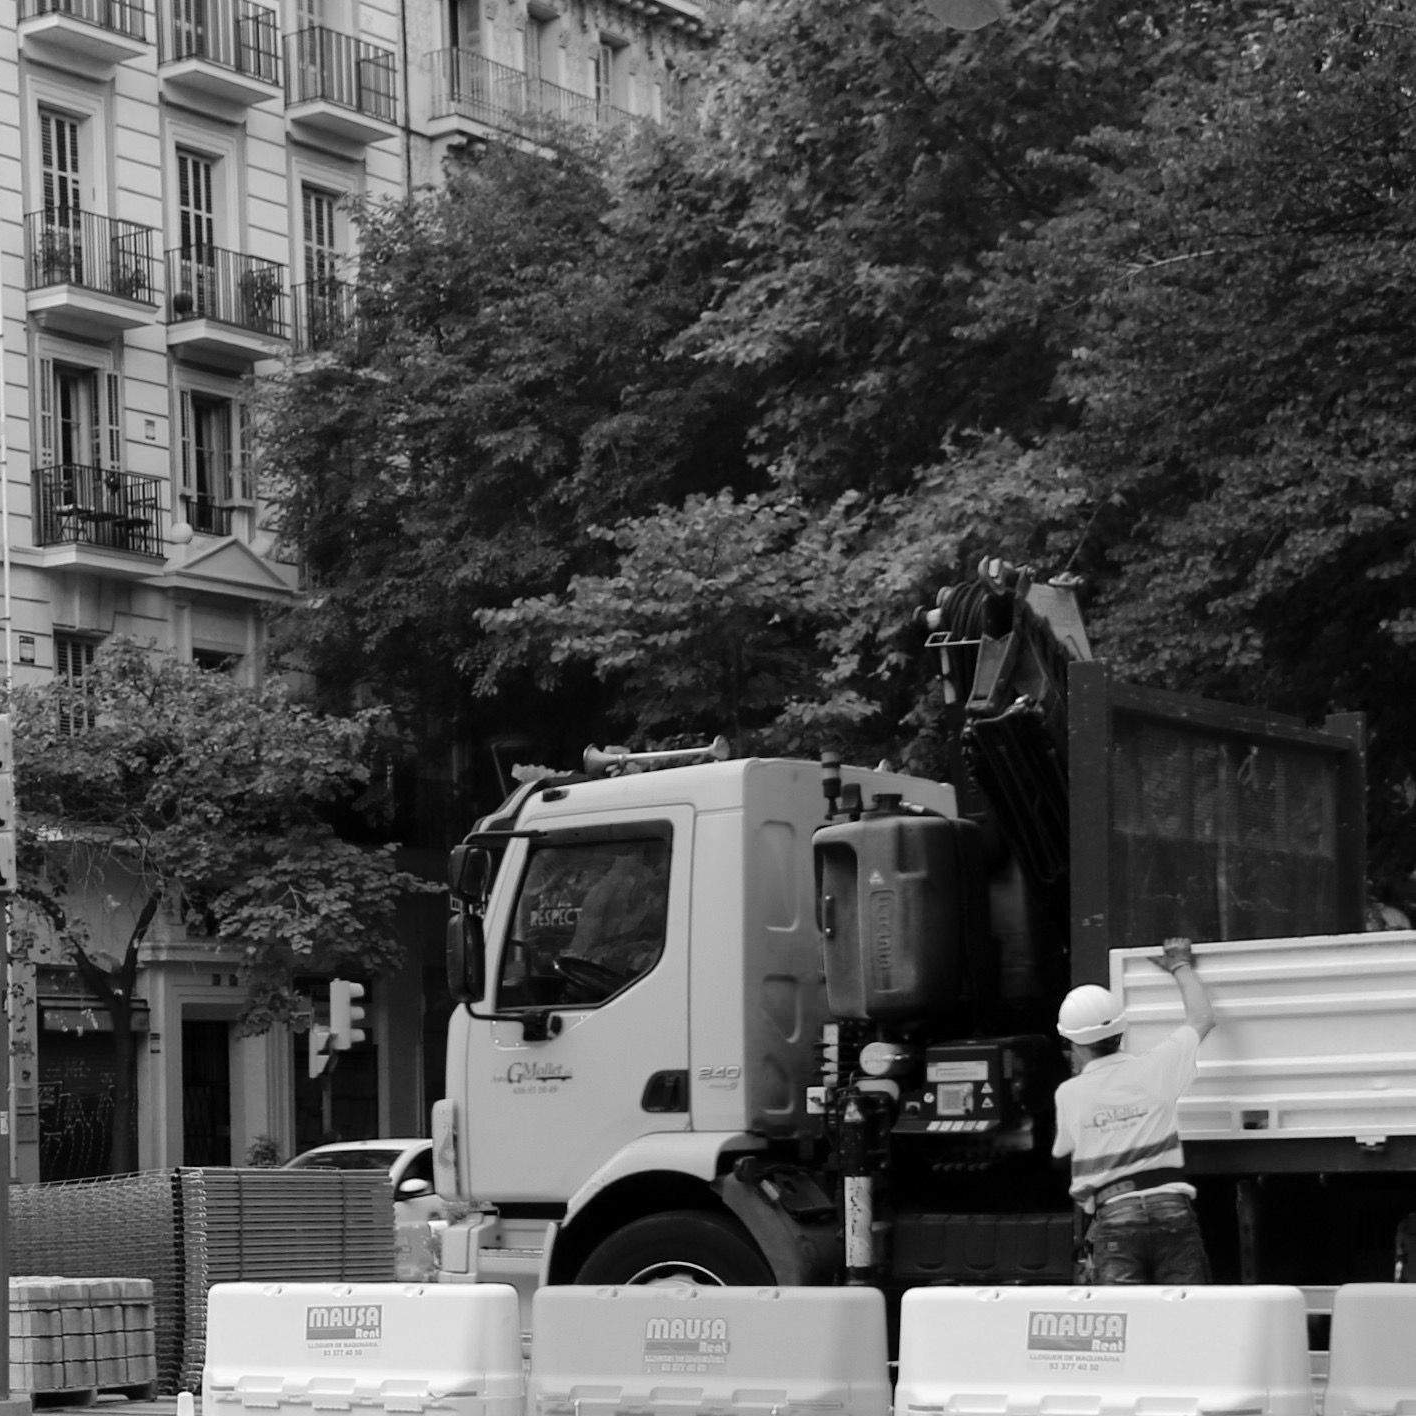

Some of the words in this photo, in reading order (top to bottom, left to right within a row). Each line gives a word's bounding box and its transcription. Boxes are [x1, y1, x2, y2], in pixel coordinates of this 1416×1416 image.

[308, 1306, 380, 1328] MAUSA
[1030, 1313, 1123, 1337] MAUSA
[354, 1327, 380, 1339] Rent
[646, 1317, 727, 1340] MAUSA
[1090, 1338, 1123, 1352] Rent
